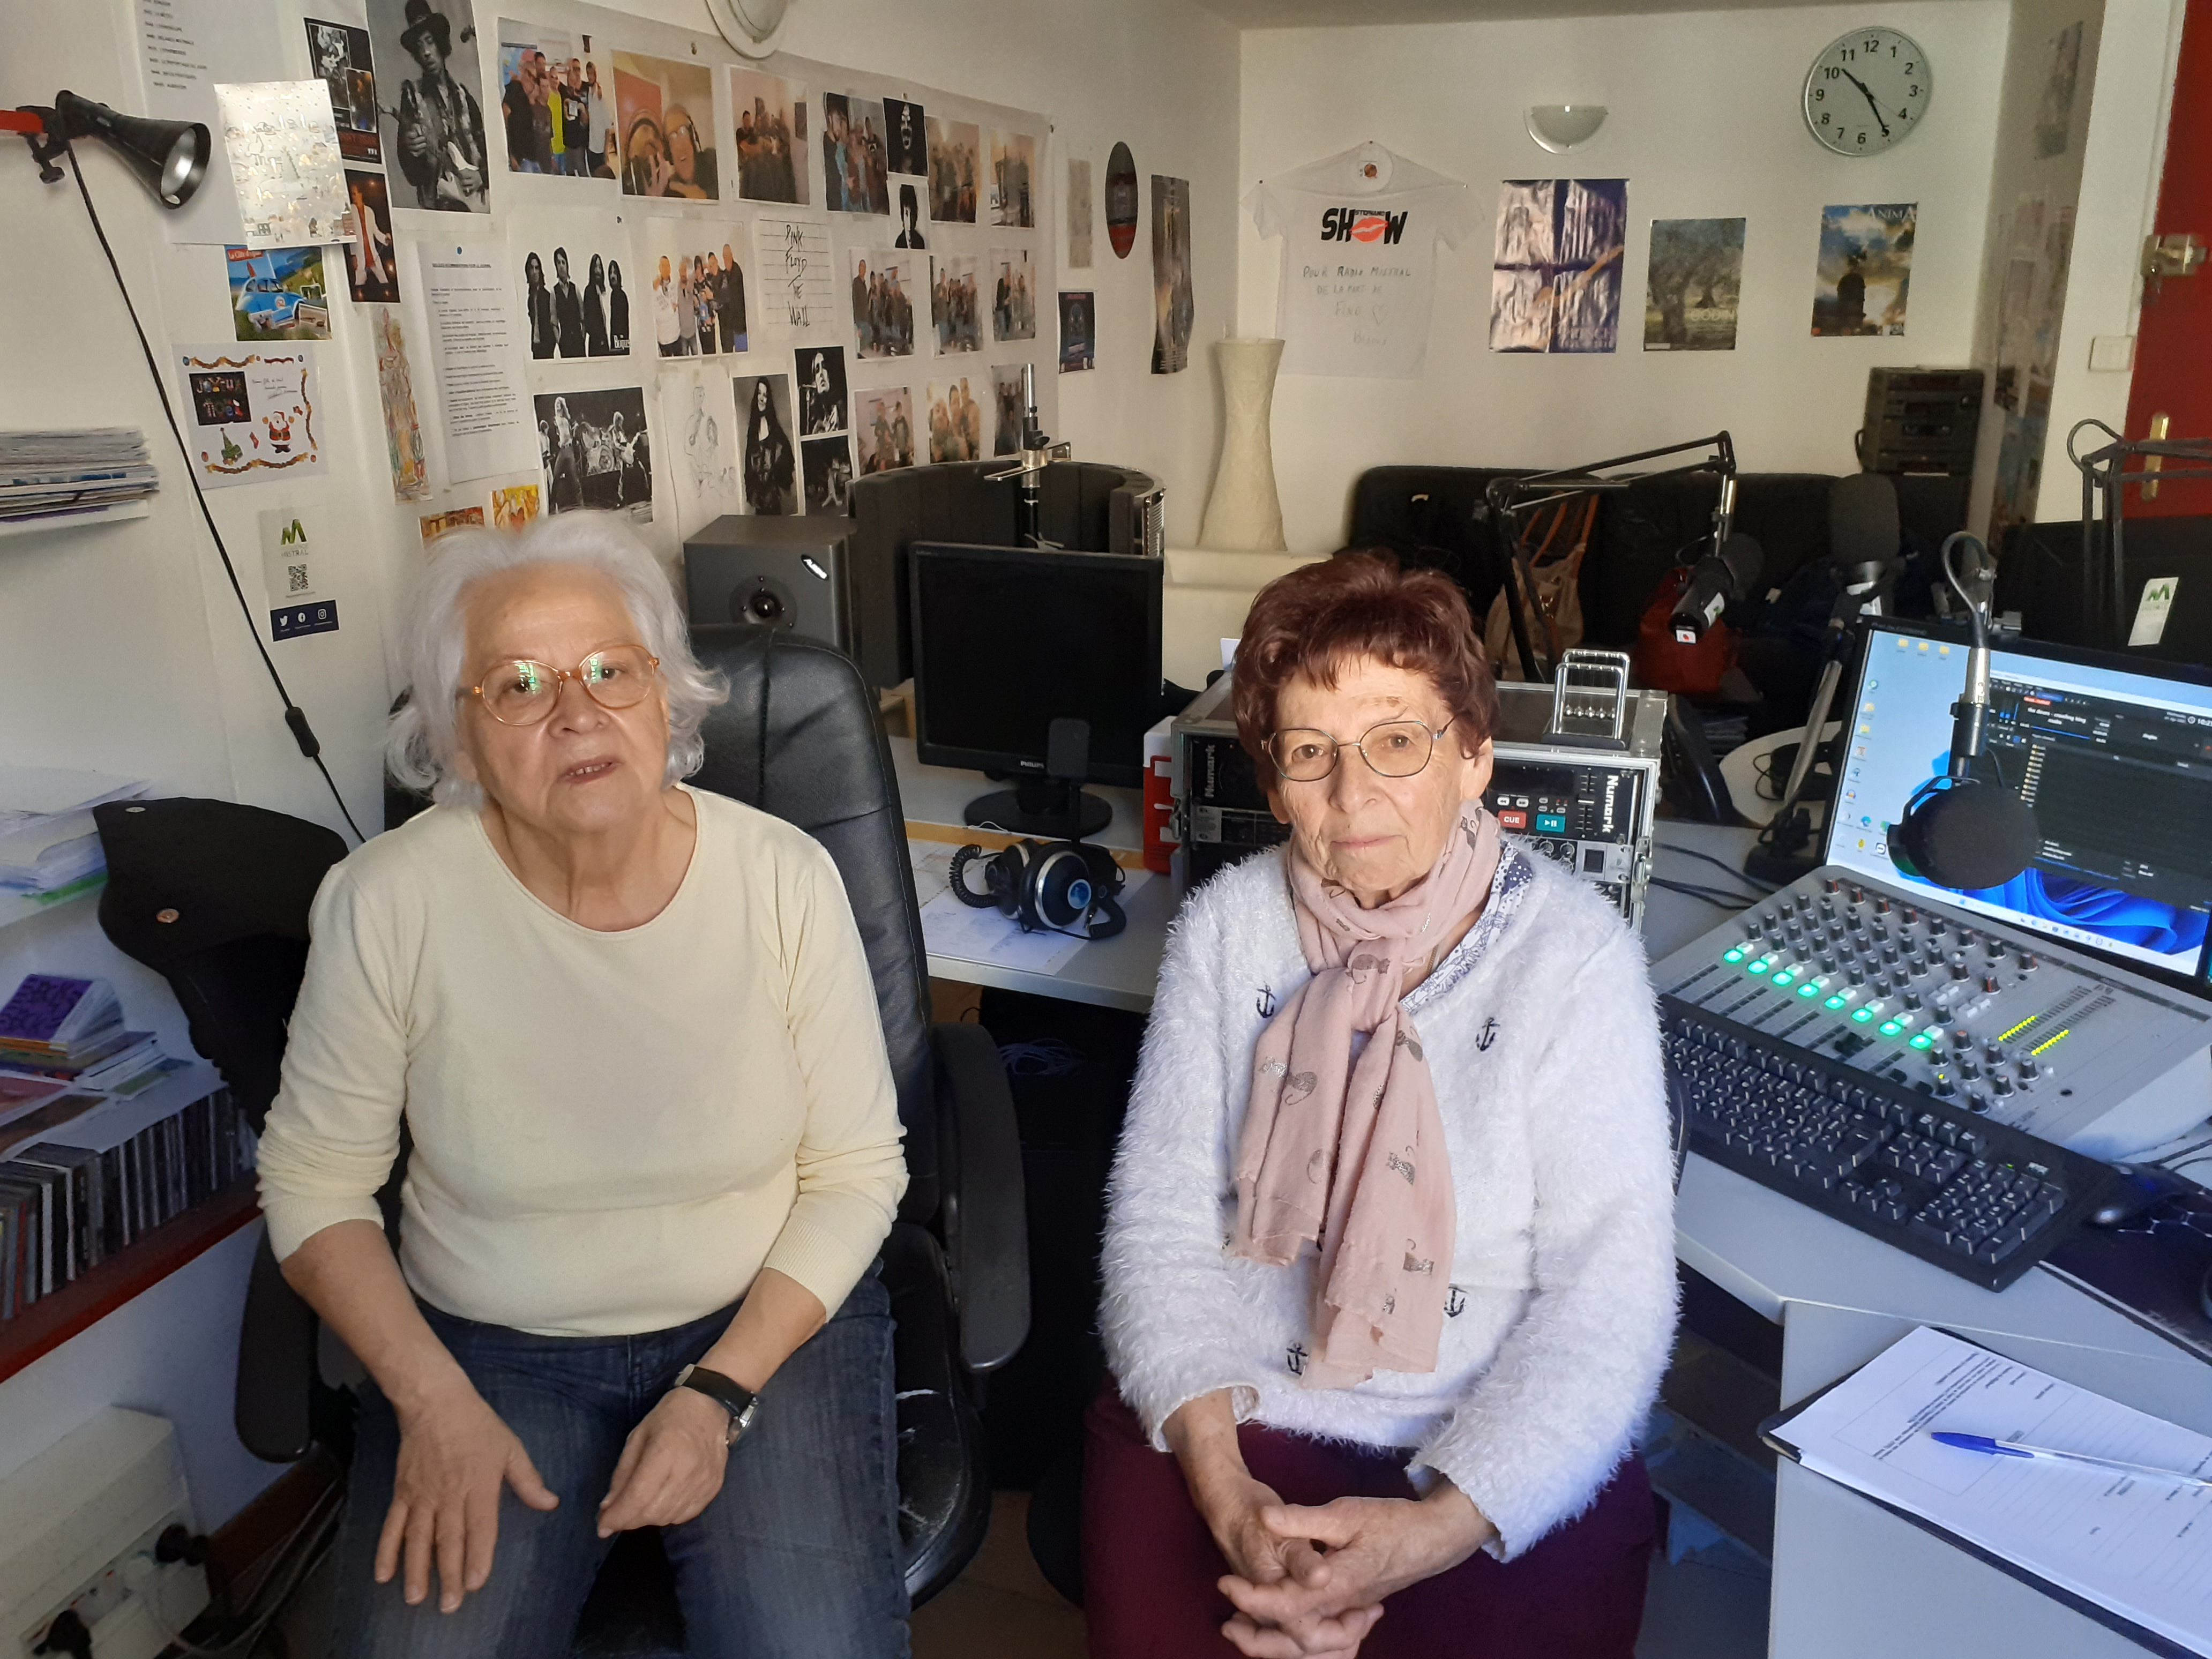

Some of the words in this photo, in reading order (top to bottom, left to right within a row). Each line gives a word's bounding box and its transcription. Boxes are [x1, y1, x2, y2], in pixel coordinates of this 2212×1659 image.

[1863, 40, 1879, 53] 12
[1890, 46, 1897, 57] 1
[1841, 49, 1855, 61] 11
[1824, 67, 1840, 79] 10
[1905, 62, 1914, 74] 2
[1815, 89, 1824, 101] 9
[1909, 85, 1918, 97] 3
[1822, 113, 1830, 125] 8
[1898, 108, 1907, 119] 4
[1837, 127, 1844, 138] 7
[1857, 132, 1866, 144] 6
[785, 225, 803, 252] PINK
[786, 246, 808, 277] FLOYD
[788, 301, 811, 327] WALL
[1204, 744, 1215, 798] Numark
[1602, 775, 1619, 834] Numark
[1504, 816, 1520, 824] CUE
